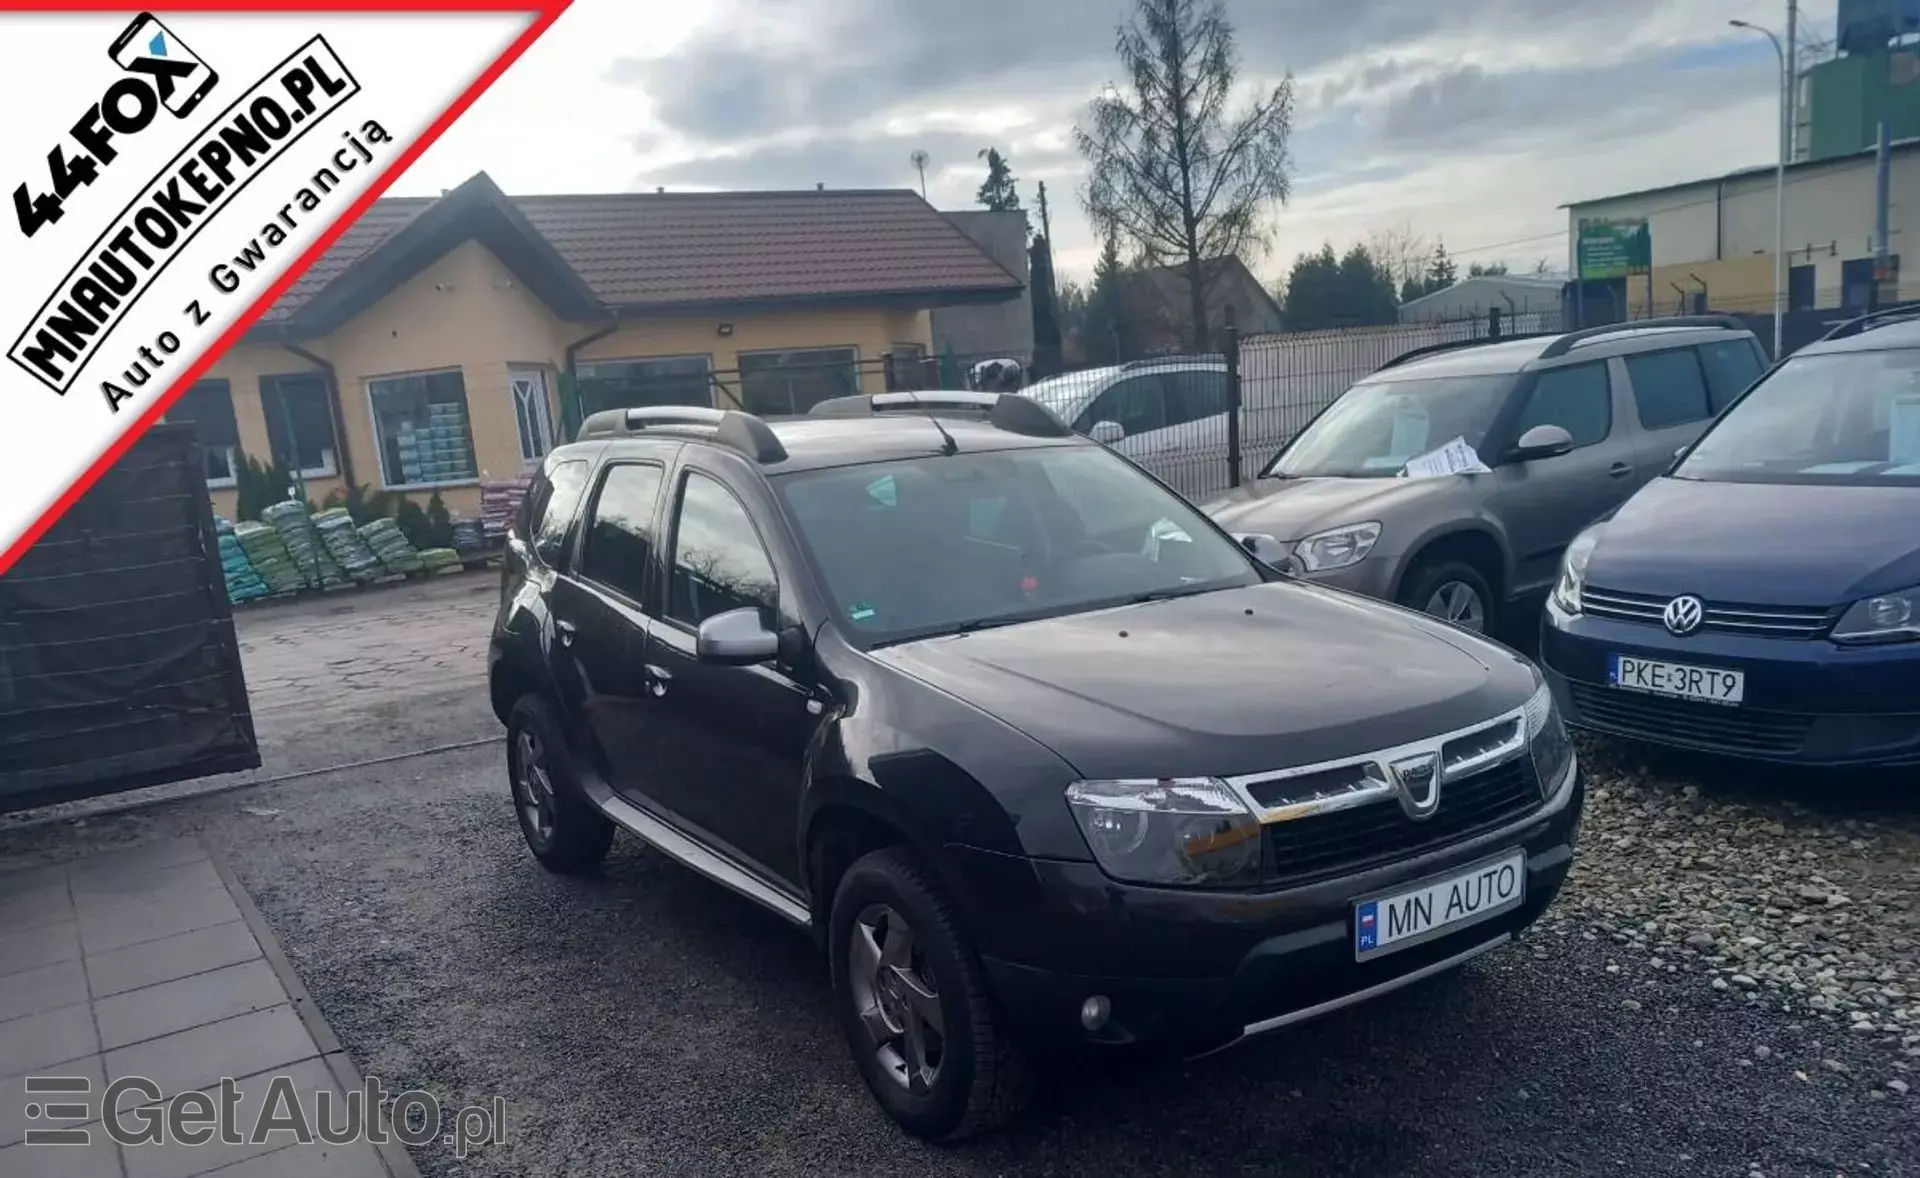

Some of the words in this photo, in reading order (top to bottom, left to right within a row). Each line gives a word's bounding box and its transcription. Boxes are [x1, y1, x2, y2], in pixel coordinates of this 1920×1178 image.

[1388, 893, 1432, 937] MN
[1445, 864, 1514, 919] AUTO
[1361, 936, 1374, 945] PL
